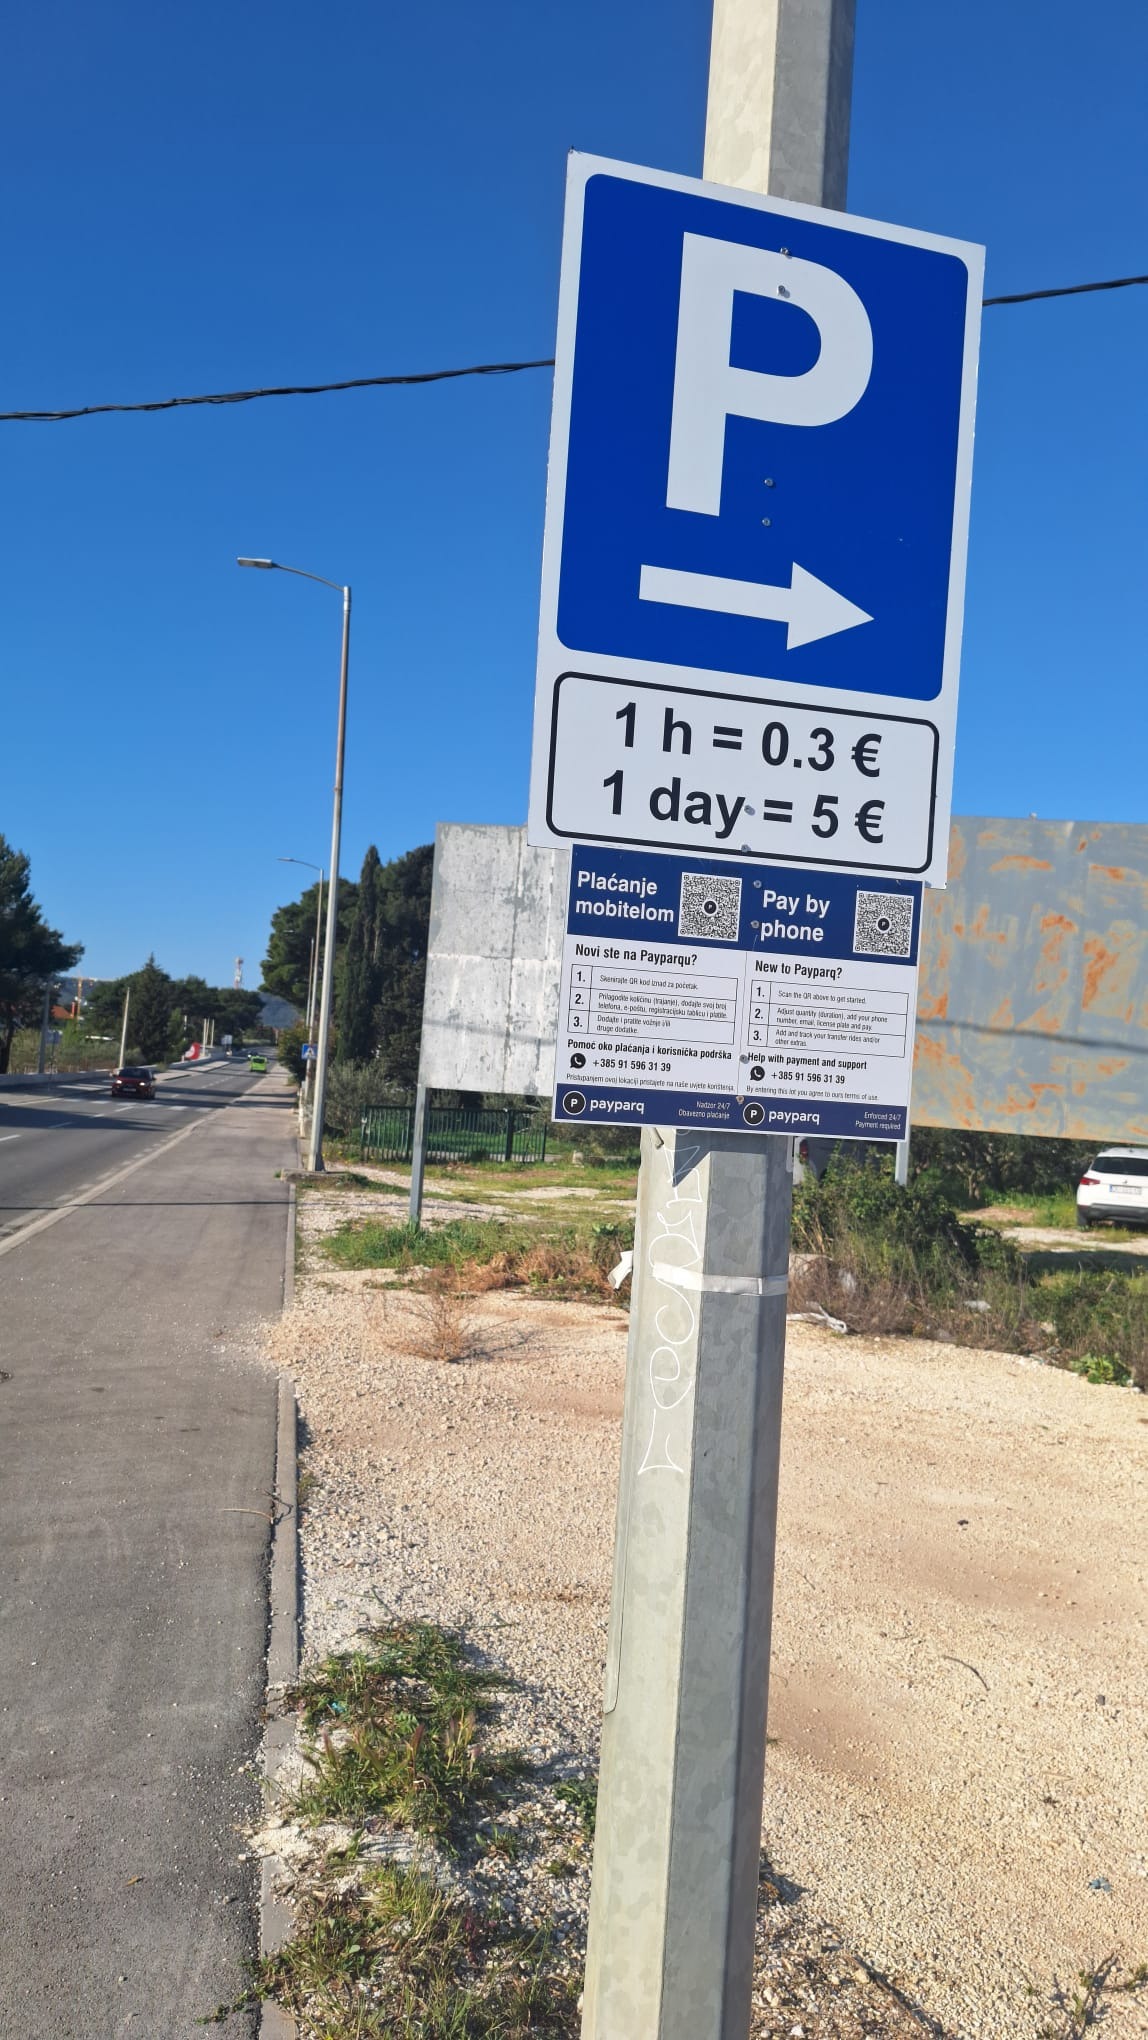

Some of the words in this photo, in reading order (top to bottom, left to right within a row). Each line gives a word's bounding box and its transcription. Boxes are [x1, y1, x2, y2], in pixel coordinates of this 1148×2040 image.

[666, 231, 873, 517] P
[616, 701, 637, 747] 1
[662, 707, 692, 755] h
[713, 725, 743, 750] =
[761, 722, 835, 771] 0.3
[851, 733, 882, 777] €
[603, 770, 623, 815] 1
[649, 777, 745, 839] day
[763, 799, 793, 823] =
[811, 794, 839, 838] 5
[854, 800, 886, 844] €
[577, 870, 658, 895] Plaćanje
[762, 890, 800, 912] Pay
[806, 894, 831, 918] by
[575, 899, 674, 923] mobitelom
[760, 921, 824, 942] phone
[576, 944, 600, 957] Novi
[603, 948, 619, 958] ste
[624, 950, 636, 961] na
[640, 950, 697, 967] Payparqu?
[755, 960, 778, 973] New
[781, 964, 791, 974] to
[795, 964, 842, 980] Payparq?
[577, 972, 586, 982] 1.
[600, 975, 628, 984] Skenirajte
[757, 987, 765, 997] 1.
[813, 993, 829, 1001] above
[575, 994, 584, 1005] 2.
[599, 993, 628, 1002] Prilagodite
[716, 1002, 726, 1010] broj
[687, 1009, 705, 1017] tablicu
[755, 1009, 763, 1019] 2.
[777, 1008, 794, 1016] Adjust
[796, 1009, 816, 1018] quantity
[573, 1017, 582, 1027] 3.
[597, 1015, 618, 1024] Dodajte
[624, 1017, 641, 1026] pratite
[817, 1020, 835, 1028] license
[597, 1025, 614, 1033] druge
[753, 1031, 761, 1041] 3.
[827, 1033, 848, 1041] transfer
[849, 1034, 862, 1042] rides
[775, 1038, 789, 1046] other
[599, 1042, 612, 1050] oko
[615, 1043, 649, 1055] plaćanja
[652, 1045, 655, 1054] i
[657, 1046, 698, 1057] korisnička
[700, 1049, 732, 1060] podrška
[593, 1059, 615, 1068] +385
[618, 1060, 627, 1069] 91
[631, 1060, 645, 1070] 596
[649, 1061, 657, 1070] 31
[661, 1062, 671, 1072] 39
[748, 1052, 765, 1063] Help
[768, 1054, 784, 1063] with
[786, 1057, 819, 1067] payment
[821, 1059, 835, 1067] and
[838, 1060, 867, 1070] support
[567, 1074, 603, 1083] Pristupanjem
[605, 1076, 618, 1084] ovoj
[619, 1077, 639, 1085] lokaciji
[640, 1079, 665, 1087] pristajete
[675, 1080, 688, 1088] naše
[690, 1082, 706, 1090] uvjete
[771, 1071, 793, 1080] +385
[795, 1072, 804, 1081] 91
[807, 1073, 821, 1082] 596
[824, 1074, 832, 1083] 31
[836, 1075, 845, 1084] 39
[755, 1086, 777, 1095] entering
[778, 1087, 787, 1095] this
[570, 1099, 577, 1107] P
[590, 1099, 645, 1114] payparq
[697, 1101, 716, 1109] Nadzor
[718, 1102, 730, 1110] 24/7
[678, 1110, 705, 1118] Obavezno
[707, 1111, 730, 1119] plaćanje
[751, 1110, 757, 1118] P
[768, 1110, 820, 1125] payparq
[864, 1112, 887, 1120] Enforced
[855, 1121, 878, 1129] Payment
